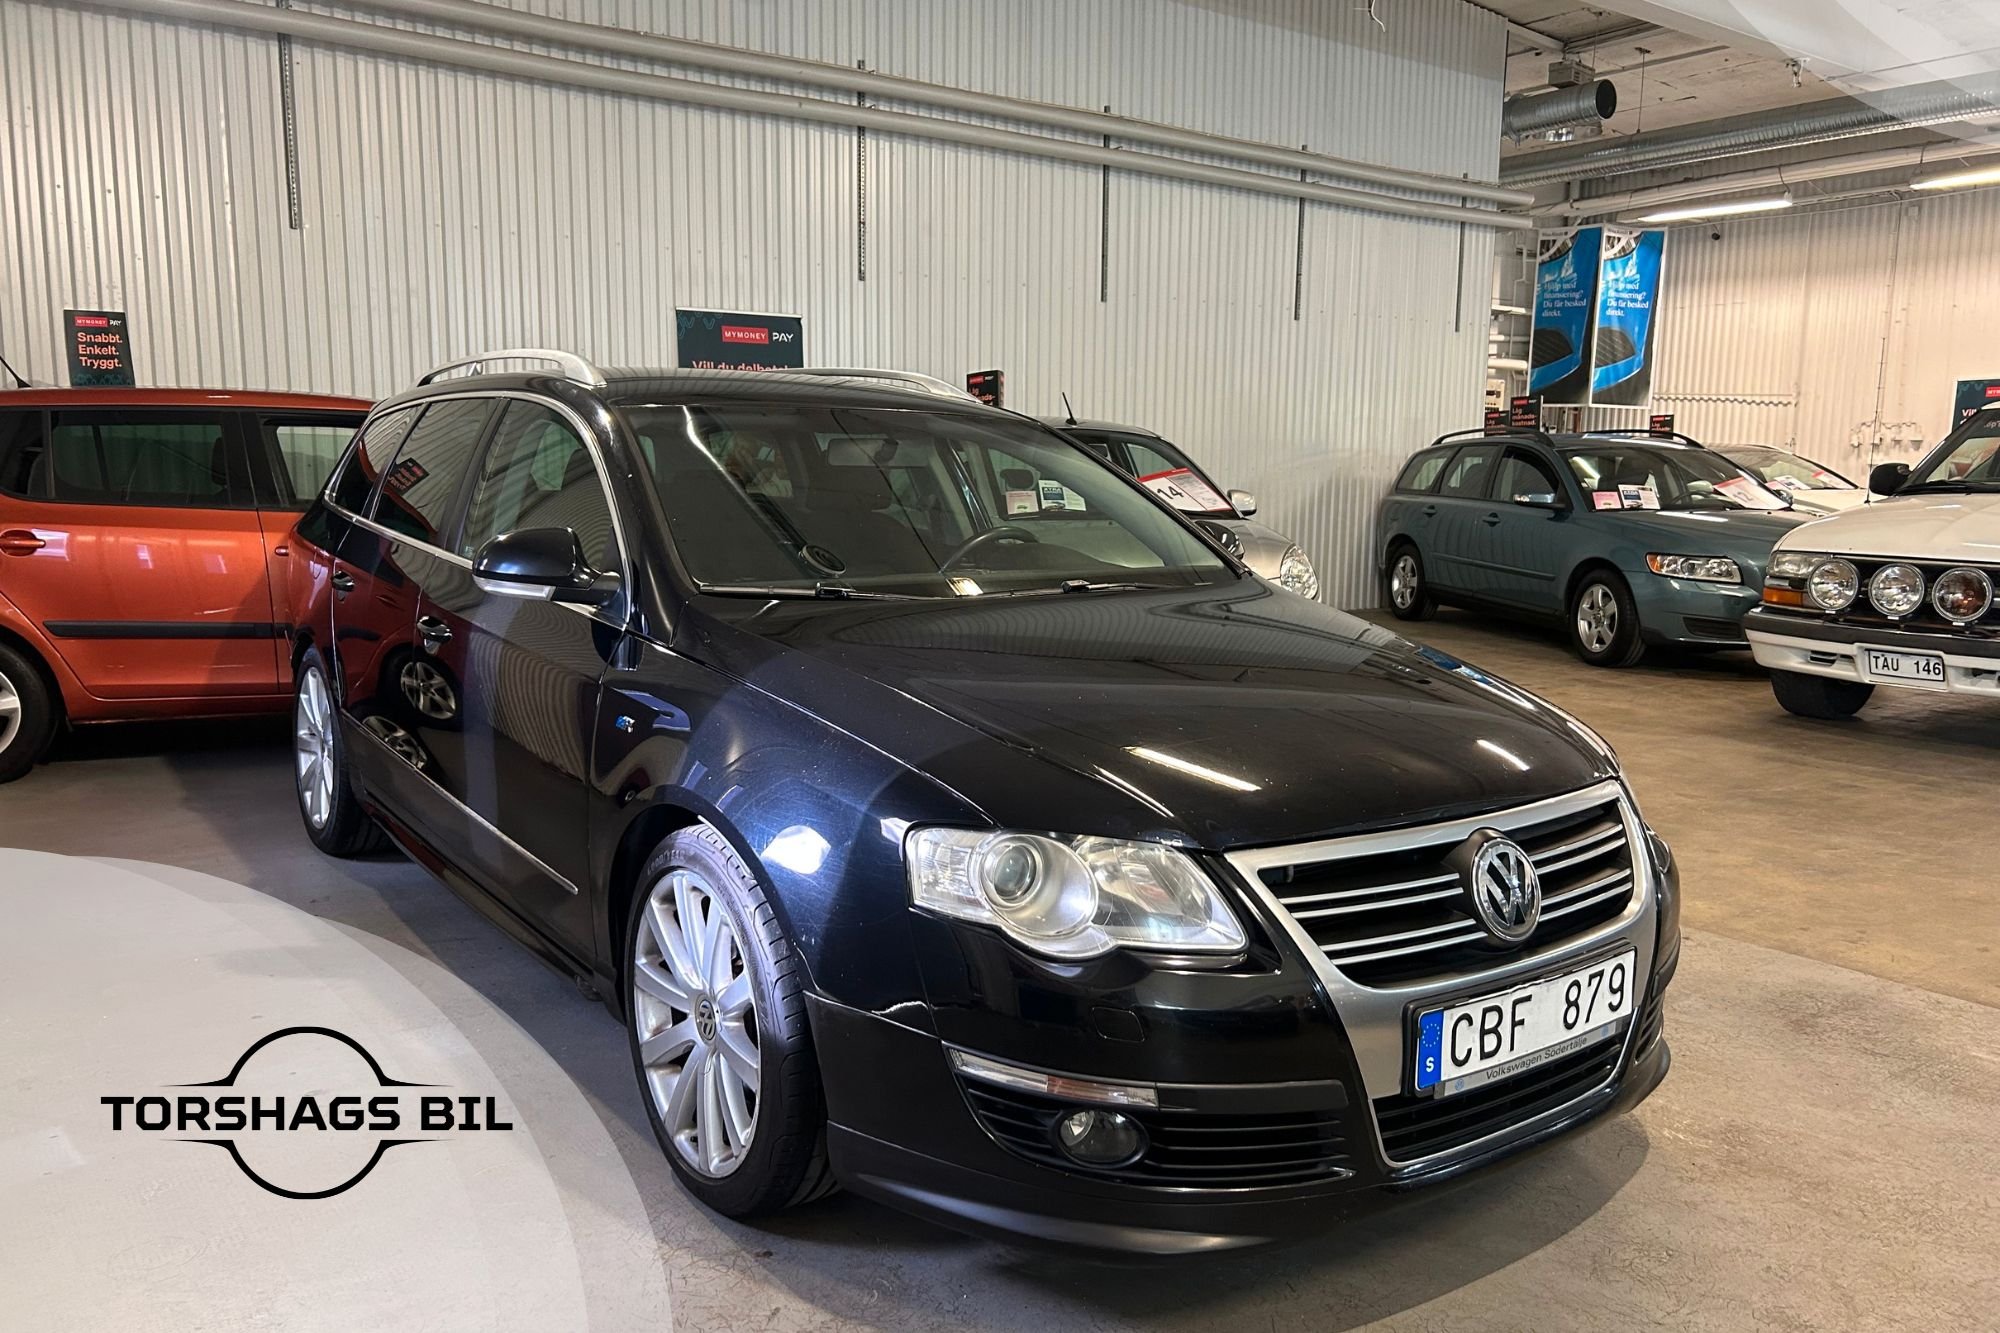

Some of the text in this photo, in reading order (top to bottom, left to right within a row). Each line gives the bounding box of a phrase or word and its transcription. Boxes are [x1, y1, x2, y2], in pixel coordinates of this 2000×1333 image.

[1564, 298, 1586, 307] besked
[1627, 300, 1649, 309] besked
[77, 332, 123, 343] Snabbt.
[724, 330, 794, 342] MYMONEY PAY
[78, 344, 120, 356] Enkelt.
[79, 356, 123, 369] Tryggt.
[1157, 486, 1185, 500] 14
[1872, 656, 1941, 676] TAU 146
[1450, 962, 1625, 1068] CBF 879
[1426, 1056, 1435, 1072] S
[1486, 1036, 1588, 1080] Volkswagen Södertälje
